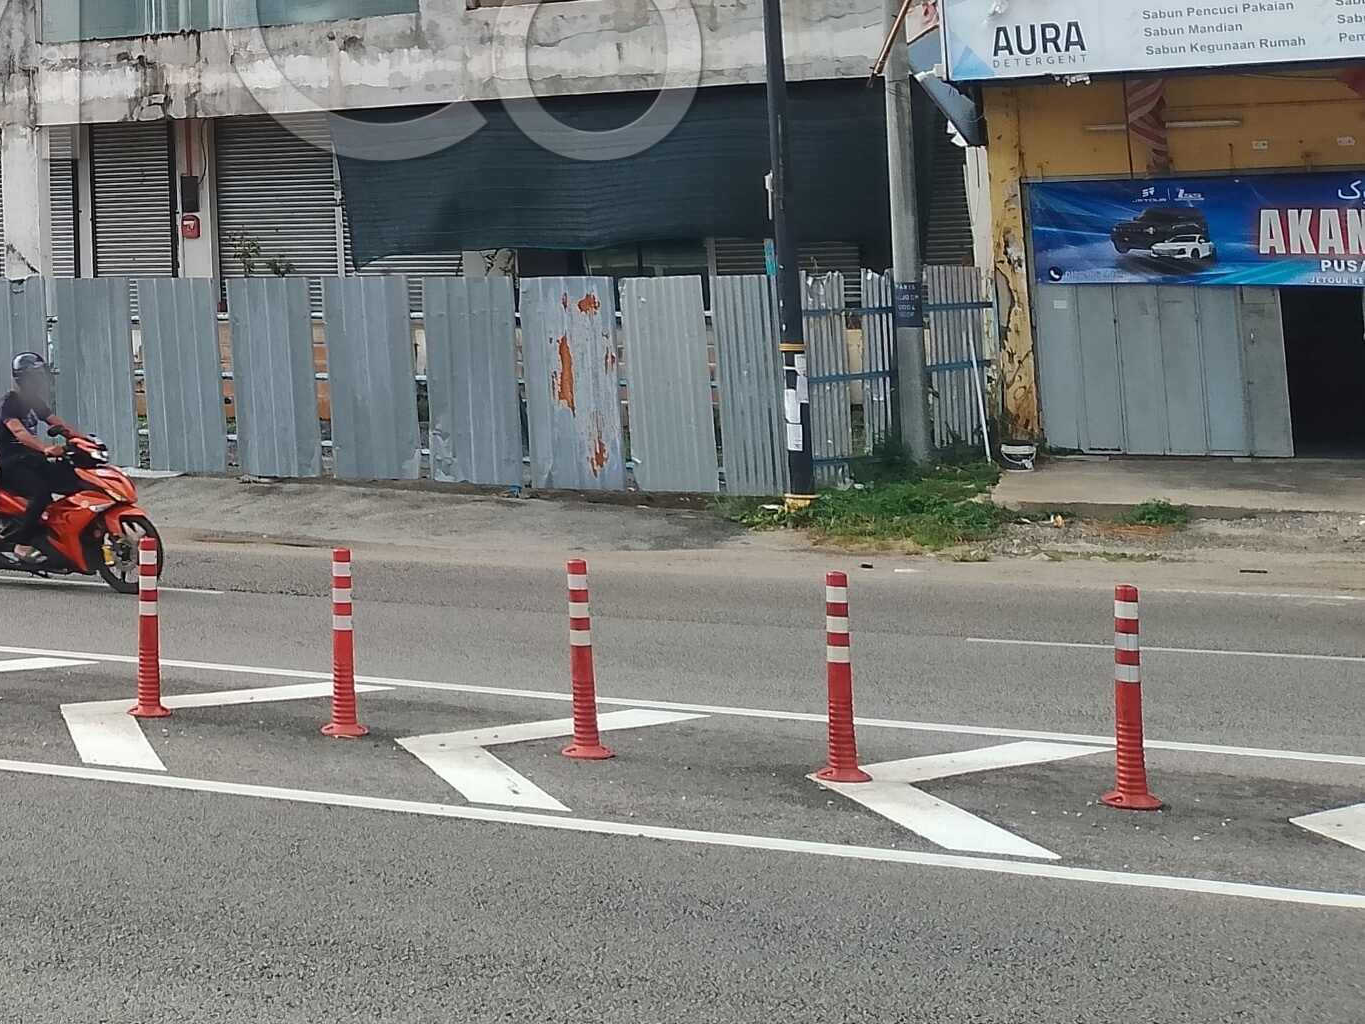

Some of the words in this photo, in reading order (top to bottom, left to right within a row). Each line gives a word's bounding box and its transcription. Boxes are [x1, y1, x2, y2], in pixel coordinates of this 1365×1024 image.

[1142, 7, 1183, 20] Sabun
[1186, 4, 1239, 17] Pencuci
[1242, 0, 1294, 13] Pakaian
[1337, 13, 1365, 24] Sab
[993, 21, 1087, 57] AURA
[1144, 25, 1184, 37] Sabun
[1188, 22, 1243, 35] Mandian
[1145, 43, 1185, 56] Sabun
[1190, 40, 1255, 55] Kegunaan
[1259, 36, 1306, 49] Rumah
[993, 54, 1087, 68] DETERGENT
[1259, 208, 1365, 255] AKAN
